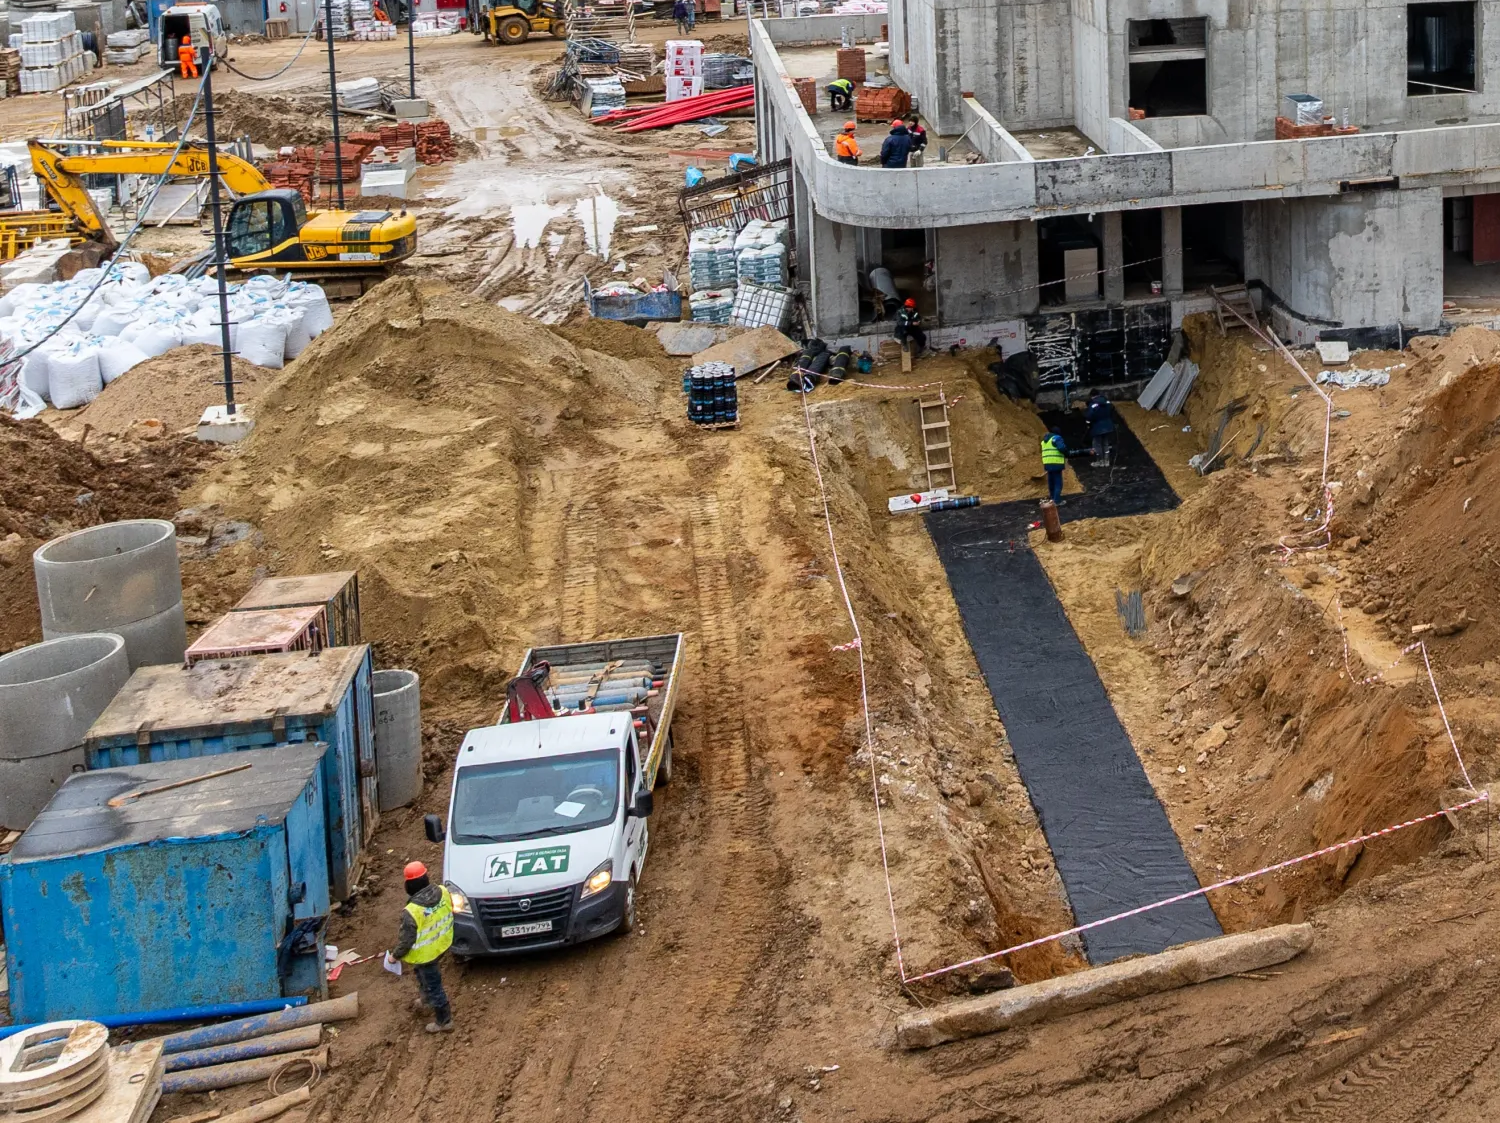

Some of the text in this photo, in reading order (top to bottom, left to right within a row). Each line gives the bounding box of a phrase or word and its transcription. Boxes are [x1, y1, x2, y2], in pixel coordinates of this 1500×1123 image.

[189, 158, 207, 172] JCB
[306, 245, 327, 260] JCB
[491, 855, 567, 878] АГАТ
